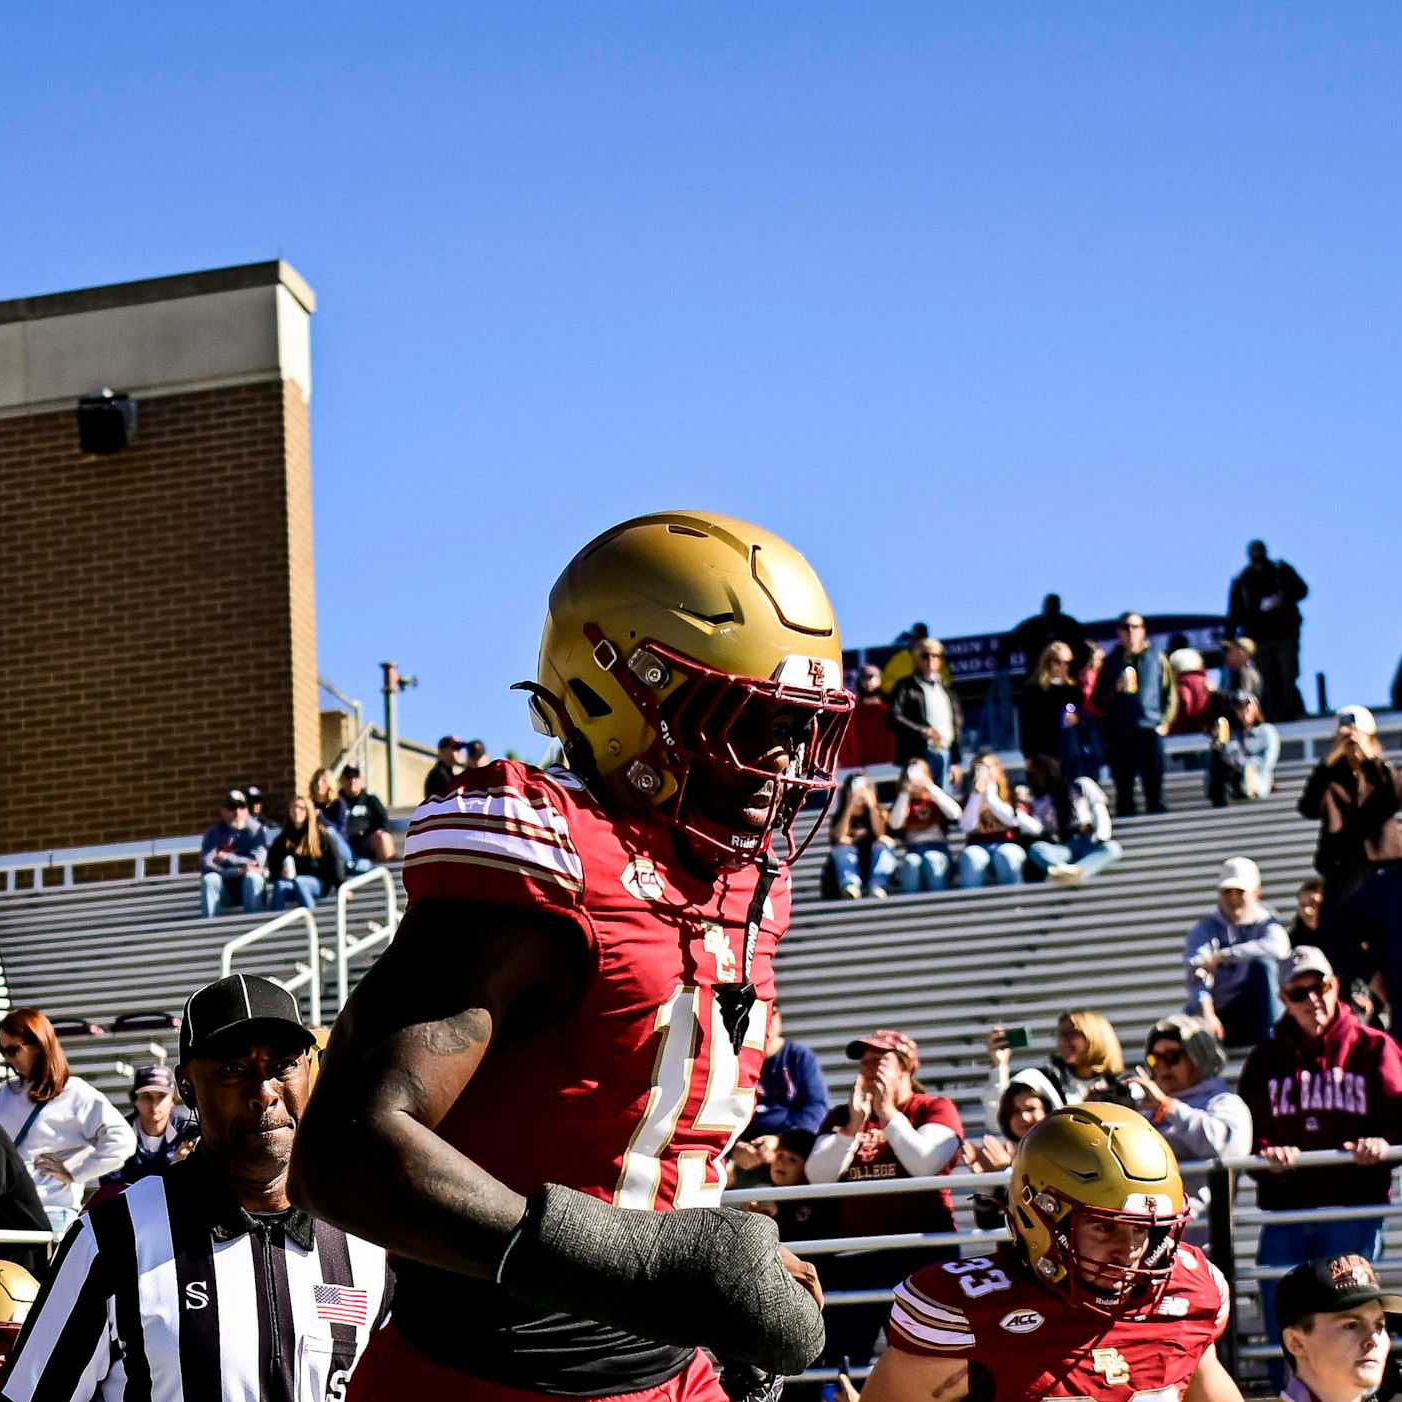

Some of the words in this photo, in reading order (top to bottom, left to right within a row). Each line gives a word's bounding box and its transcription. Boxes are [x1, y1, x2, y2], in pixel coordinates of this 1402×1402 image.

[848, 1163, 897, 1180] OLLEGE
[185, 1280, 210, 1310] S
[1006, 1313, 1038, 1327] ACC
